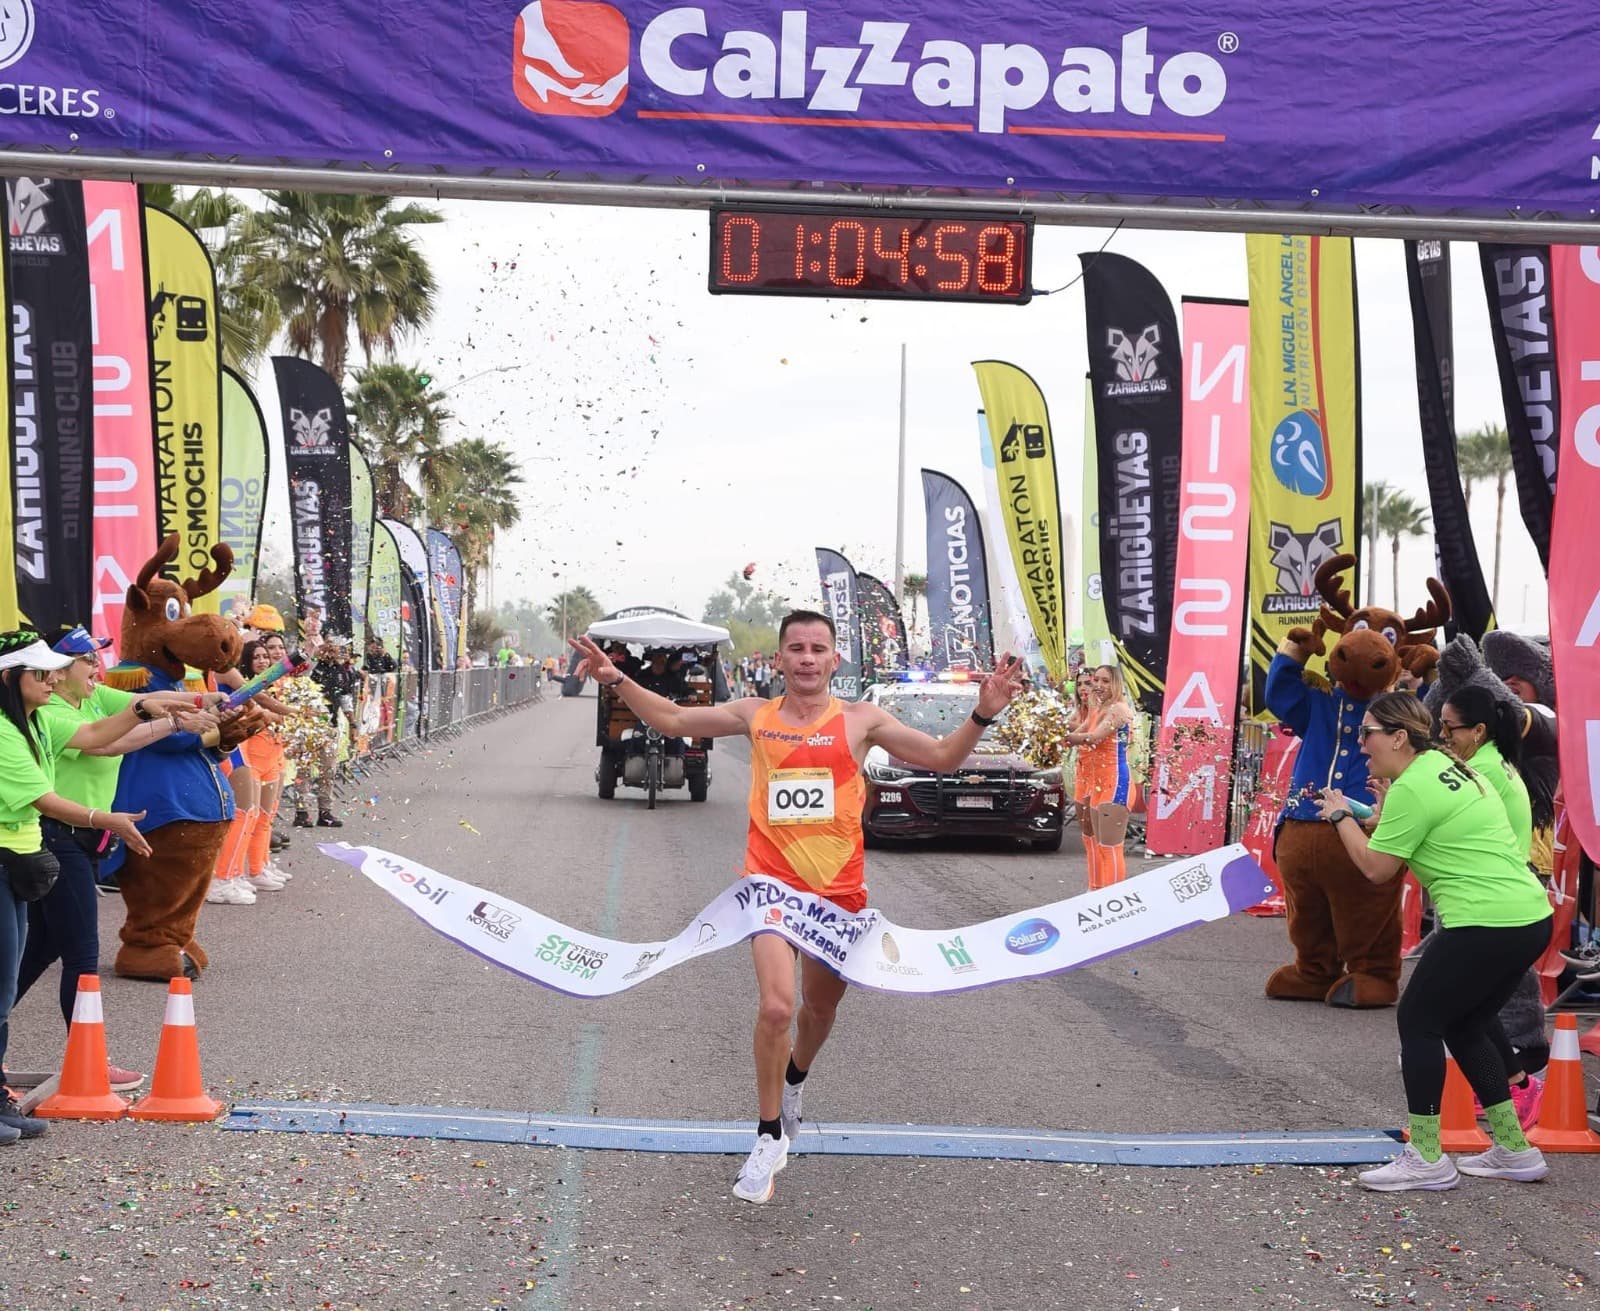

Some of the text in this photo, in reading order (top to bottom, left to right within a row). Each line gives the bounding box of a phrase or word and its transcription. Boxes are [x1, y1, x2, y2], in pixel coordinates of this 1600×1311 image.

[640, 7, 1227, 134] Calzzapato
[723, 217, 1014, 291] 01:04:58
[1279, 251, 1294, 307] ÁNGEL
[1282, 312, 1296, 373] MIGUEL
[1297, 308, 1310, 406] NUTRICIÓN
[1110, 431, 1155, 635] ZARIGÜEYAS
[776, 788, 824, 809] 002
[377, 857, 449, 905] Mobil
[1169, 863, 1208, 891] BERRY
[1173, 878, 1210, 903] NUTS
[1078, 892, 1143, 927] AVON
[1081, 906, 1148, 934] MIRA DE NUEVO
[466, 914, 512, 940] NOTICIAS
[1008, 927, 1049, 947] Solural
[567, 951, 604, 970] UNO
[572, 943, 608, 960] STEREO
